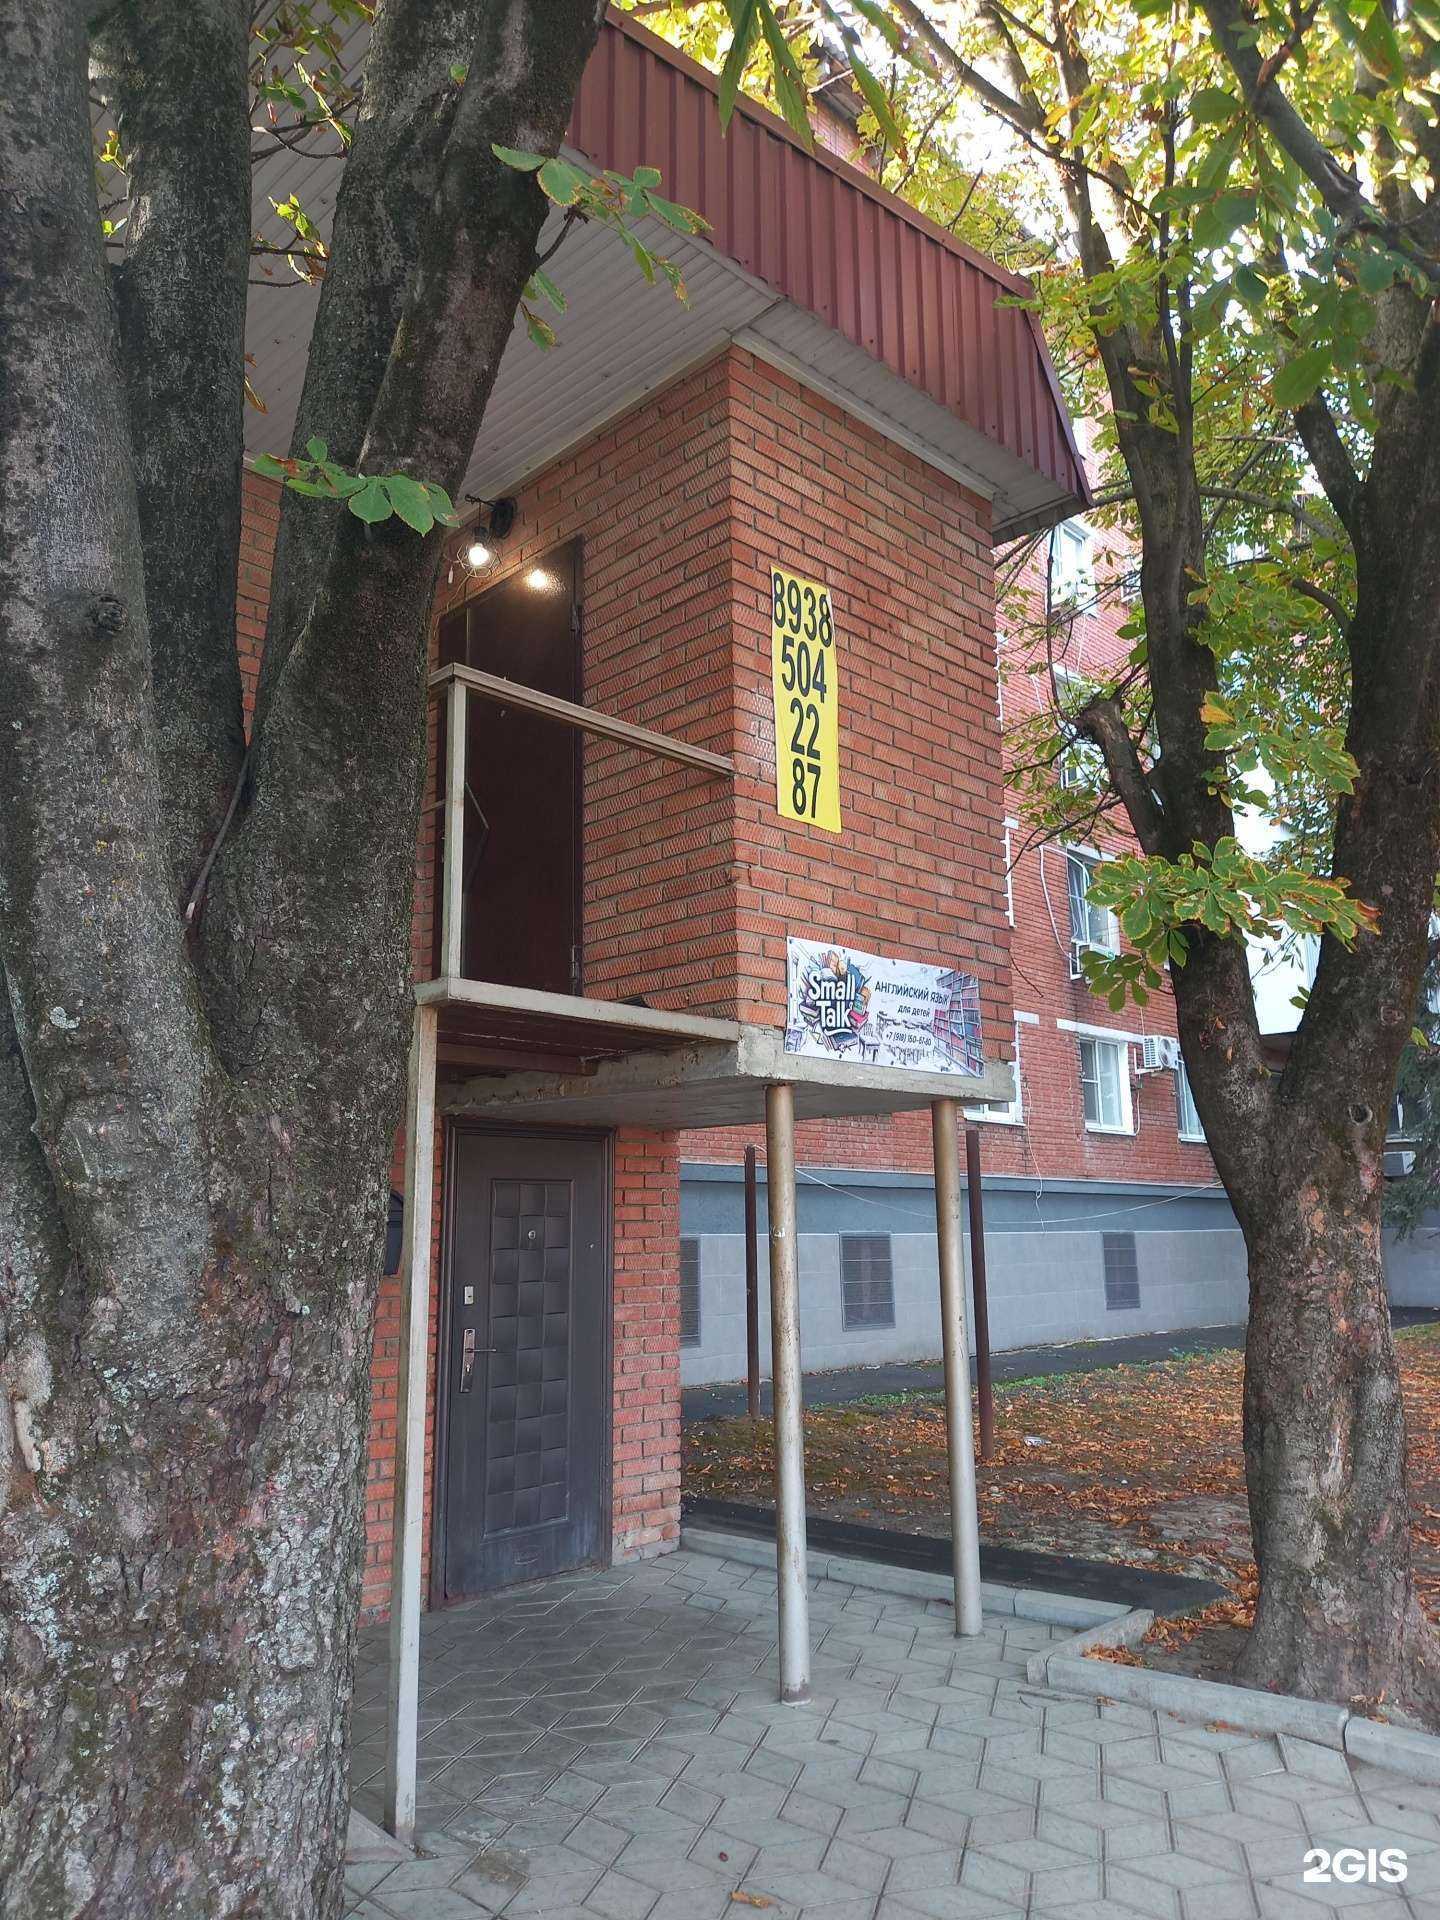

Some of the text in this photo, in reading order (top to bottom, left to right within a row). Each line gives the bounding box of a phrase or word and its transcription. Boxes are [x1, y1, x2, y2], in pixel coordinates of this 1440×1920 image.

[774, 572, 833, 648] 8938
[782, 636, 827, 703] 504
[790, 697, 821, 761] 22
[792, 758, 821, 819] 87
[808, 971, 855, 1001] Small
[875, 980, 949, 1005] АНГЛИЙСКИЙ ЯЗЫК
[816, 1002, 851, 1029] Talk
[897, 1005, 930, 1018] для детей
